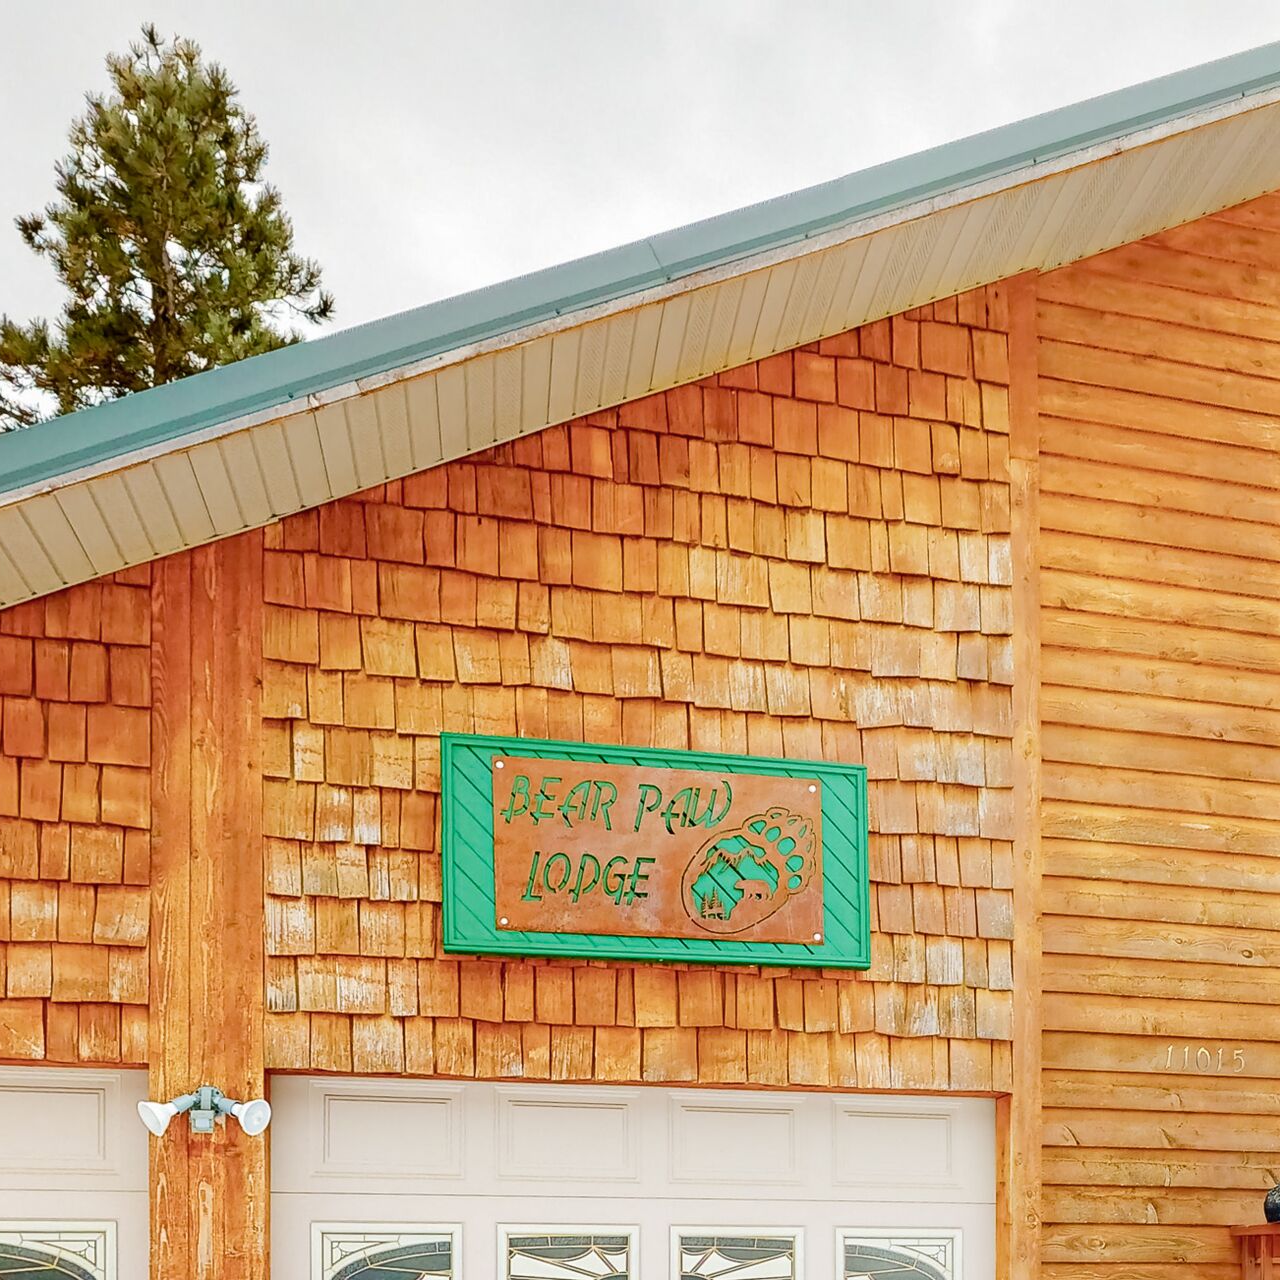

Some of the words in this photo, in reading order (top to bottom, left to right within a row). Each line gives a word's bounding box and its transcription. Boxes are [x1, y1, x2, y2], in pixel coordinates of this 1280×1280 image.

[500, 774, 618, 831] BEAR
[633, 780, 733, 835] PAW
[522, 850, 657, 906] LODGE
[1165, 1044, 1246, 1073] 11015
